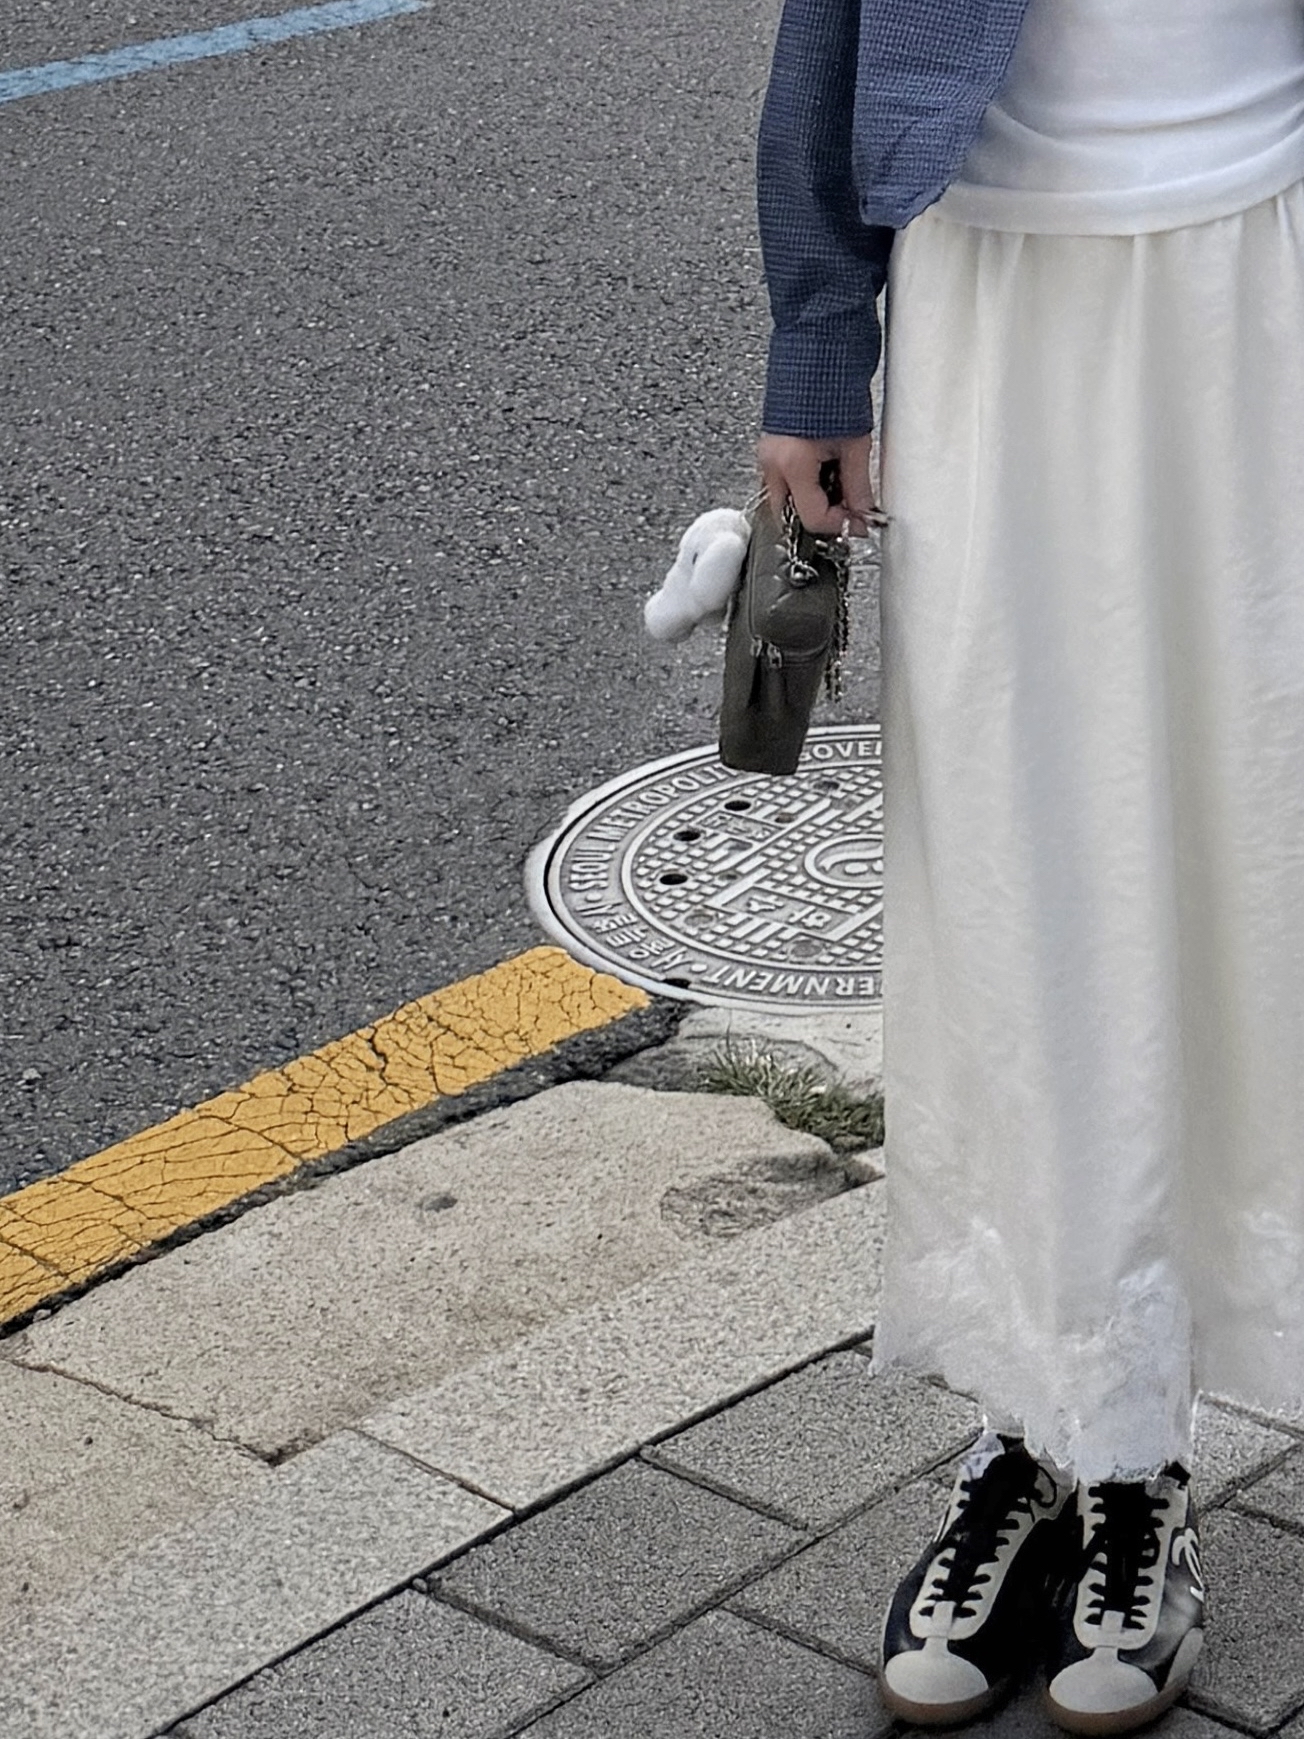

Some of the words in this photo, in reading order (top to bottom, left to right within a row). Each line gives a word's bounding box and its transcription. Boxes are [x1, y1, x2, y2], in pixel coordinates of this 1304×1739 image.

[586, 762, 738, 842] METROPOLIT
[568, 844, 616, 891] SEOUL
[701, 964, 883, 996] ERNMENT
